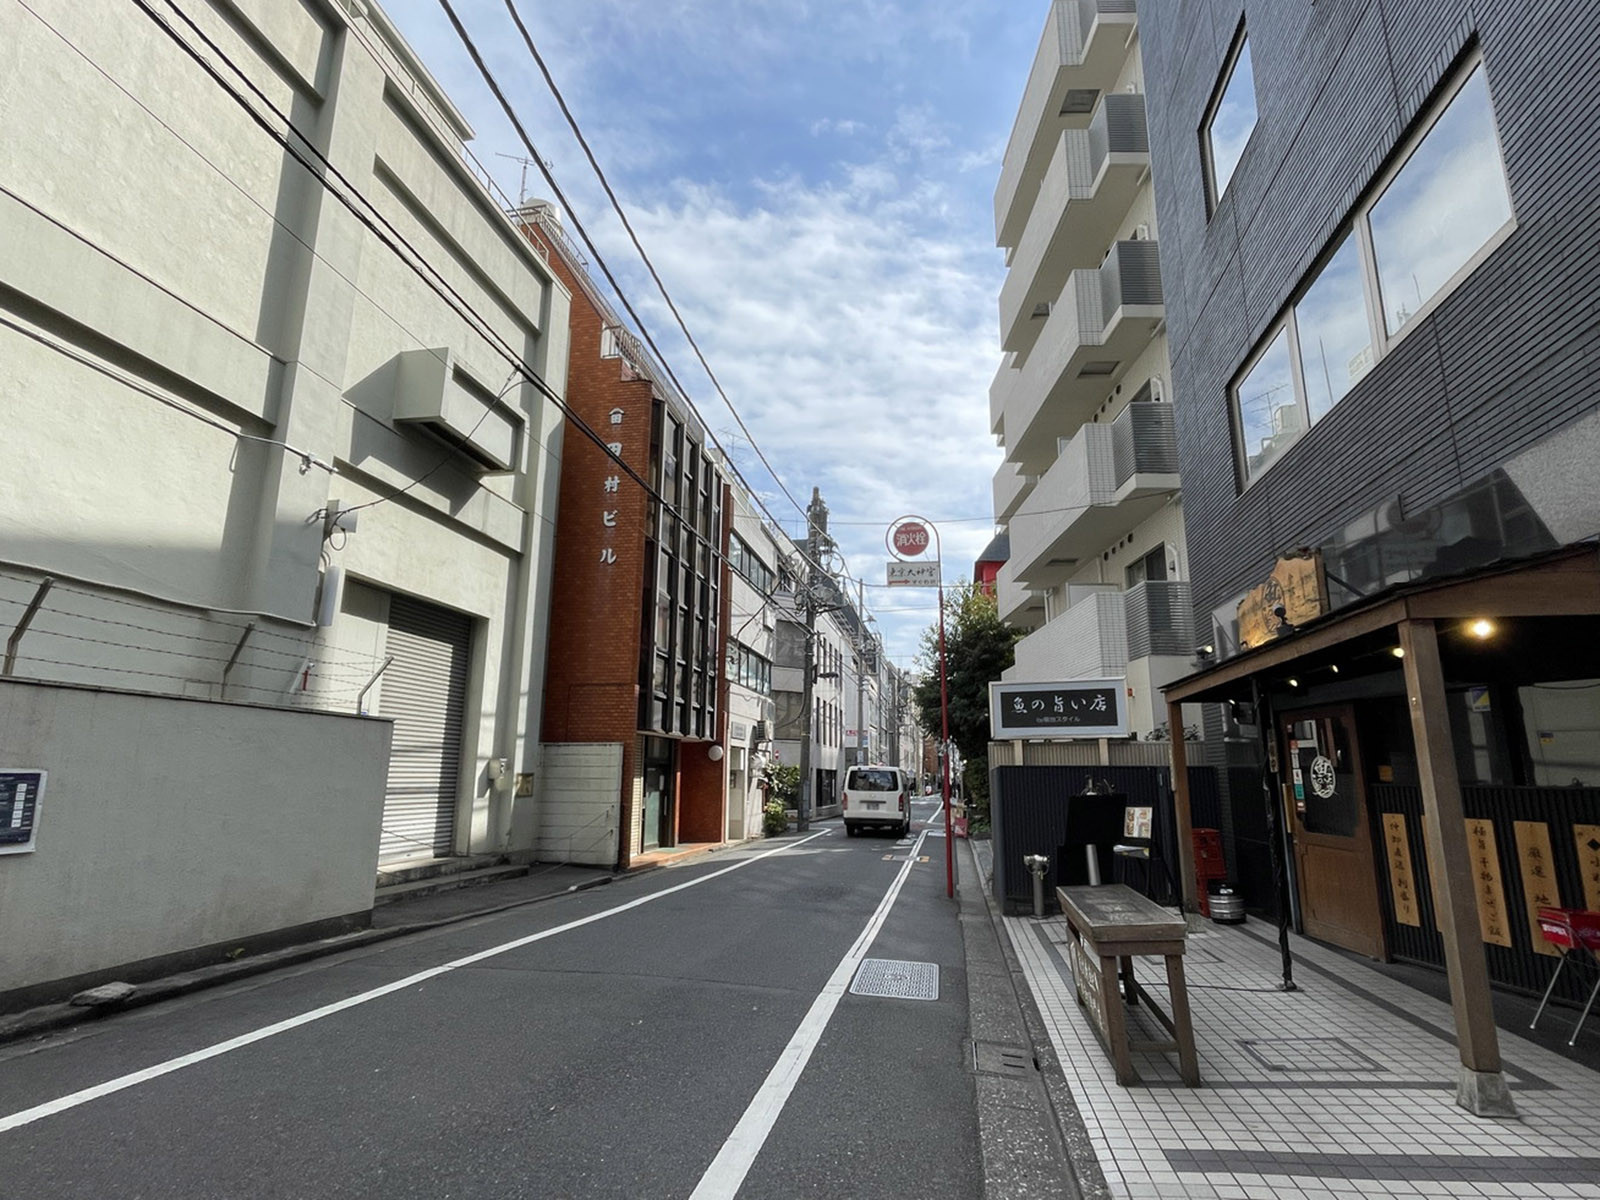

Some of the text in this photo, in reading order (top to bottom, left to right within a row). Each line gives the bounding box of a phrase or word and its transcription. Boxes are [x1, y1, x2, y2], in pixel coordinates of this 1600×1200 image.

[896, 531, 926, 547] 消火栓
[1011, 694, 1107, 713] 魚の旨い店
